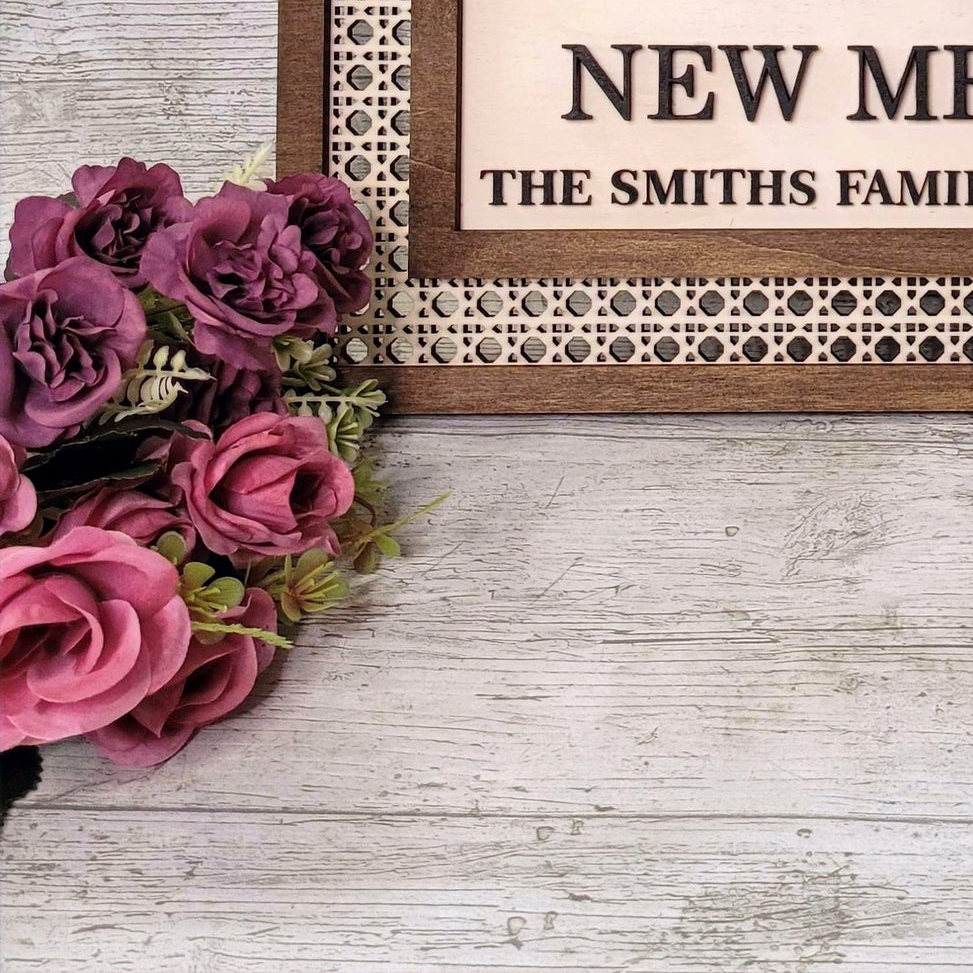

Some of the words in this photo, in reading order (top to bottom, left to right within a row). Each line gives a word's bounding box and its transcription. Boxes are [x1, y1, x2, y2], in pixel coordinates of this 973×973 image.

[561, 45, 818, 123] NEW
[480, 169, 591, 206] THE
[612, 169, 816, 206] SMITHS
